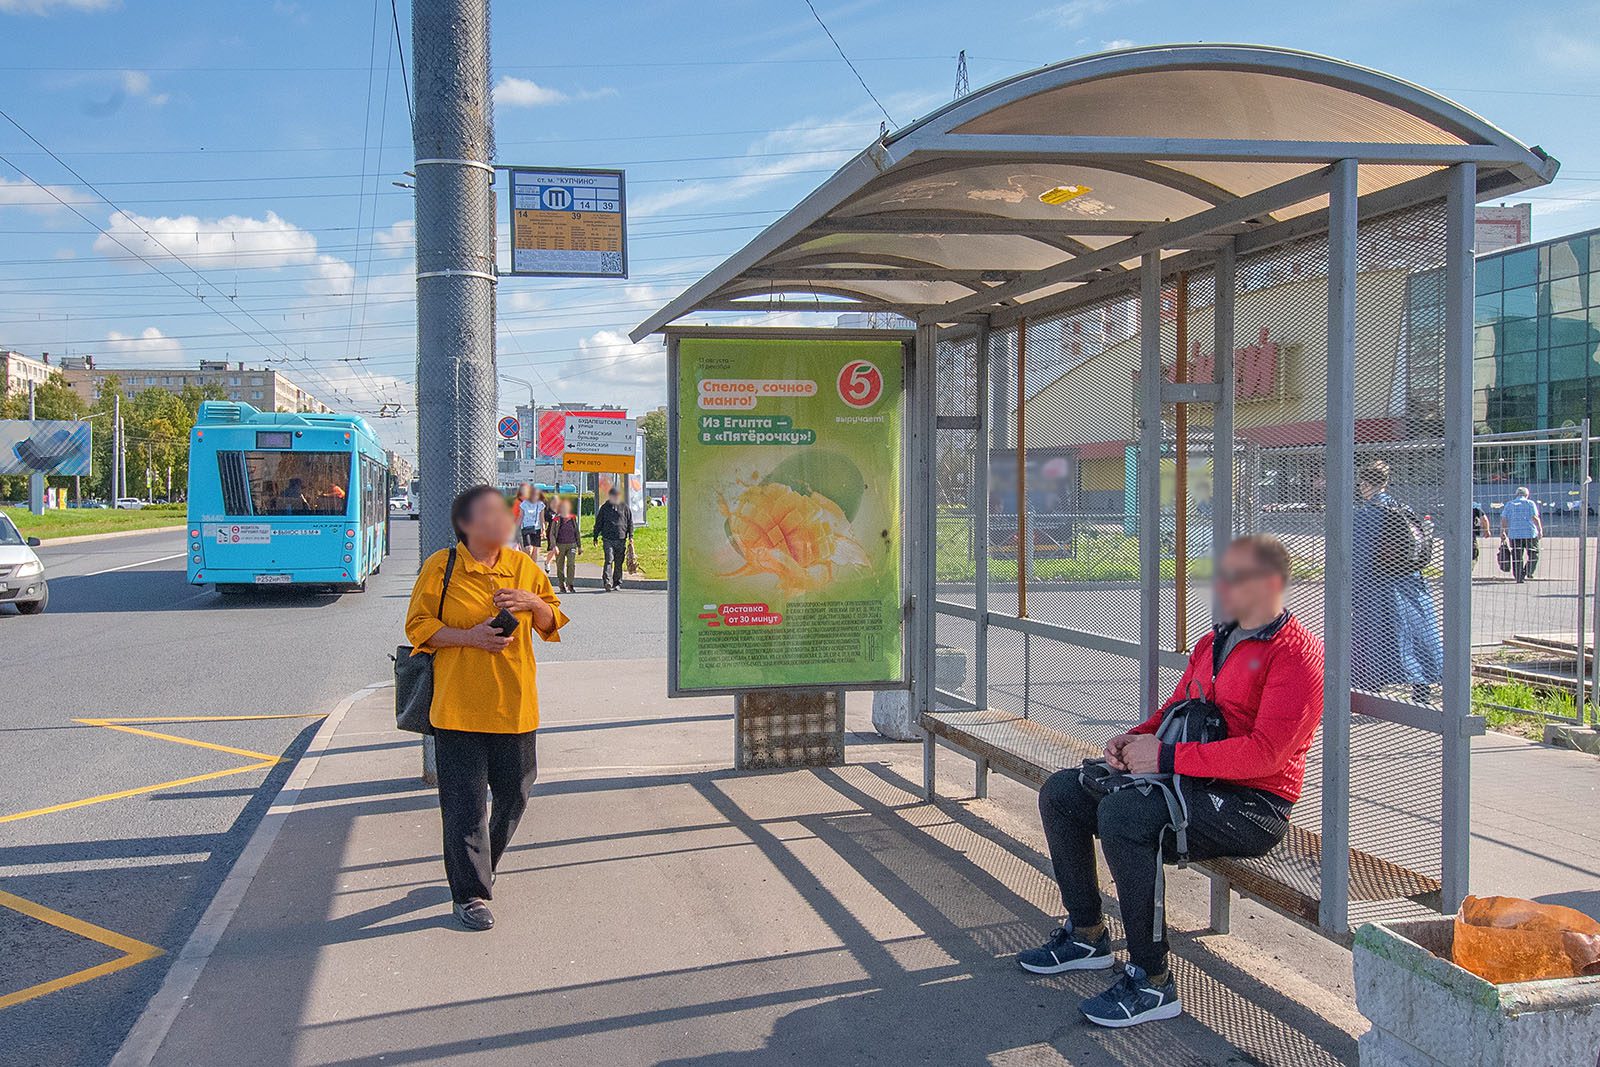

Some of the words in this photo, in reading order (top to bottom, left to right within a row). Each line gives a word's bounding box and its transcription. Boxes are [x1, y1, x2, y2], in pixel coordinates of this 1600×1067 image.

[580, 201, 590, 209] 14
[602, 202, 613, 210] 39
[518, 210, 528, 218] 14
[571, 212, 581, 220] 39
[702, 381, 759, 394] Спелое,
[762, 382, 813, 393] сочное
[702, 396, 752, 406] манго!
[702, 417, 720, 428] Из
[724, 417, 772, 429] Египта
[835, 416, 885, 424] выручает!
[703, 433, 711, 442] в
[715, 429, 812, 444] «Пятёрочку»!
[723, 606, 763, 614] Доставка
[751, 616, 778, 624] минут
